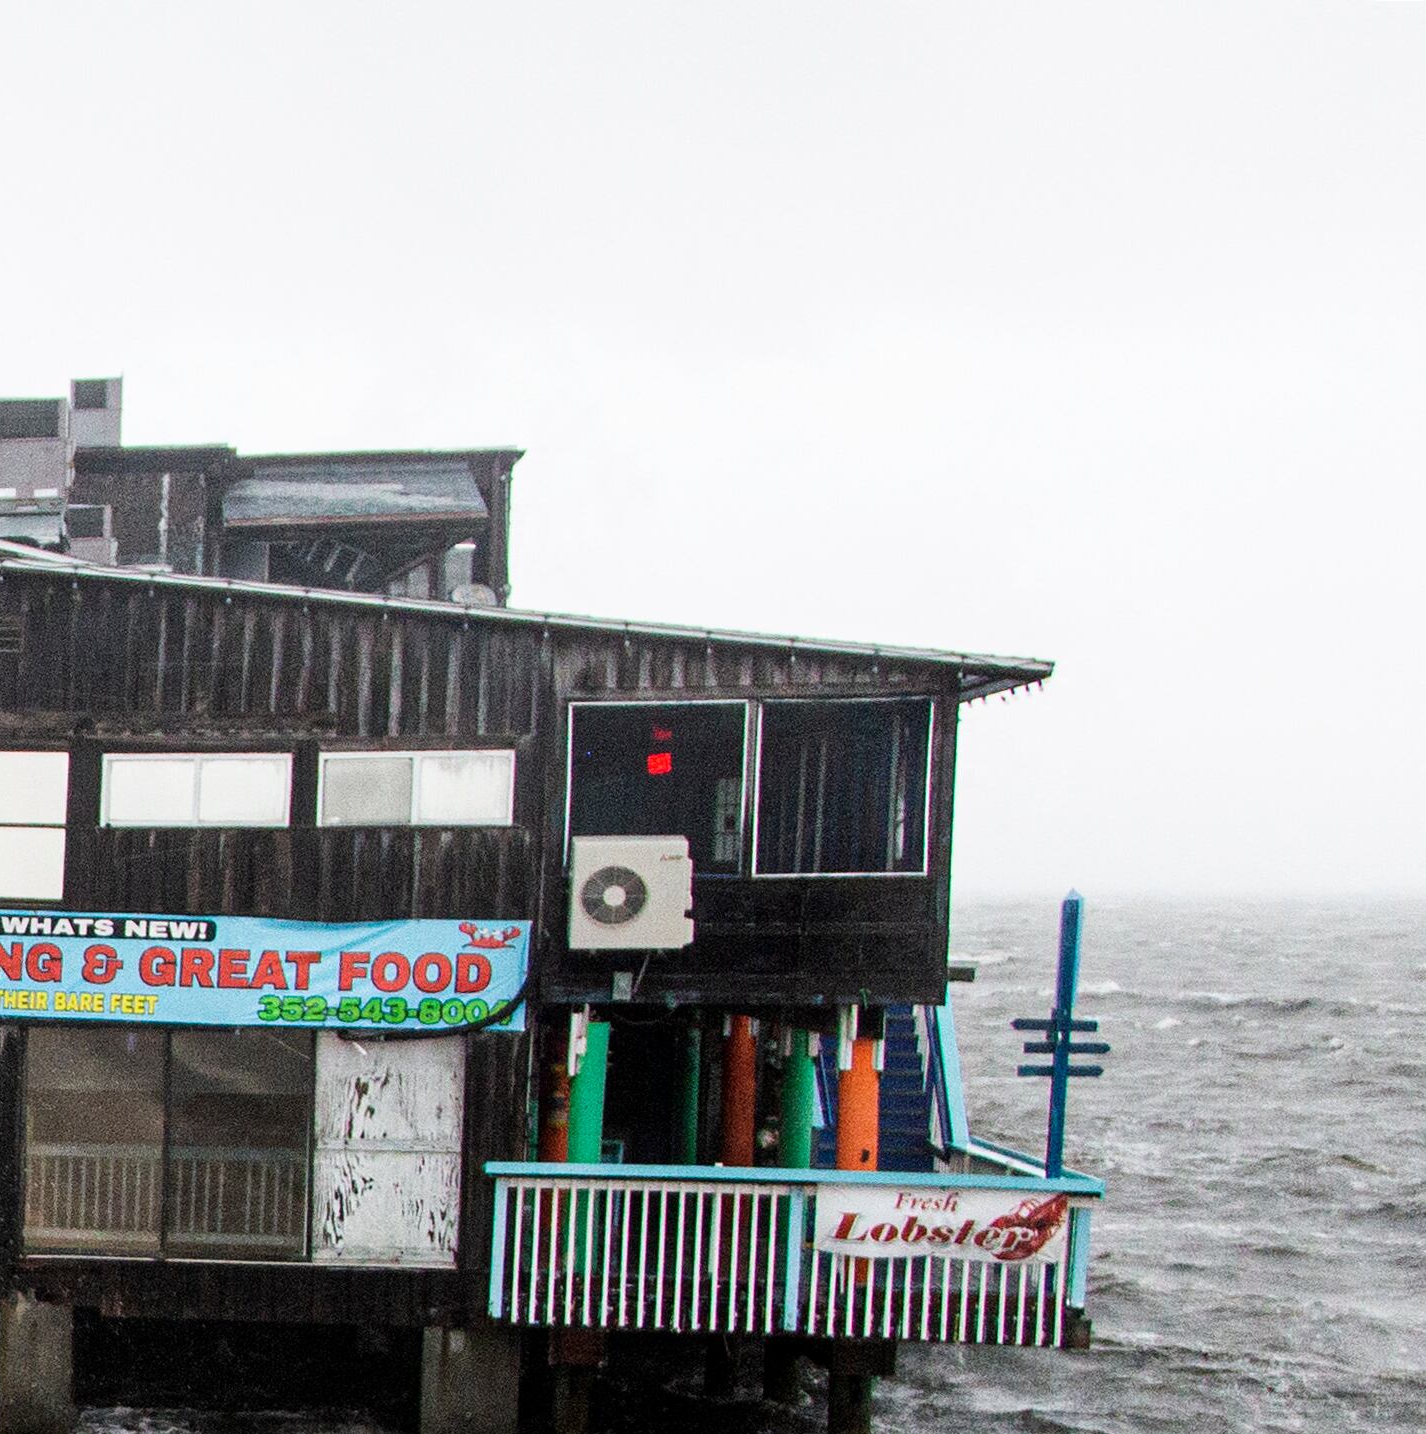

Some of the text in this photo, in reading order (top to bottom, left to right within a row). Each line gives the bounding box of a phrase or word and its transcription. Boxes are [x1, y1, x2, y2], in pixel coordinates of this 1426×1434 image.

[2, 916, 116, 938] WHATS
[124, 919, 208, 940] NEW!
[81, 944, 123, 984] &
[138, 946, 322, 991] GREAT
[338, 951, 492, 994] FOOD
[54, 992, 109, 1014] BARE
[110, 993, 159, 1015] FEET
[894, 1191, 959, 1212] Fresh
[831, 1211, 1034, 1250] Lobster
